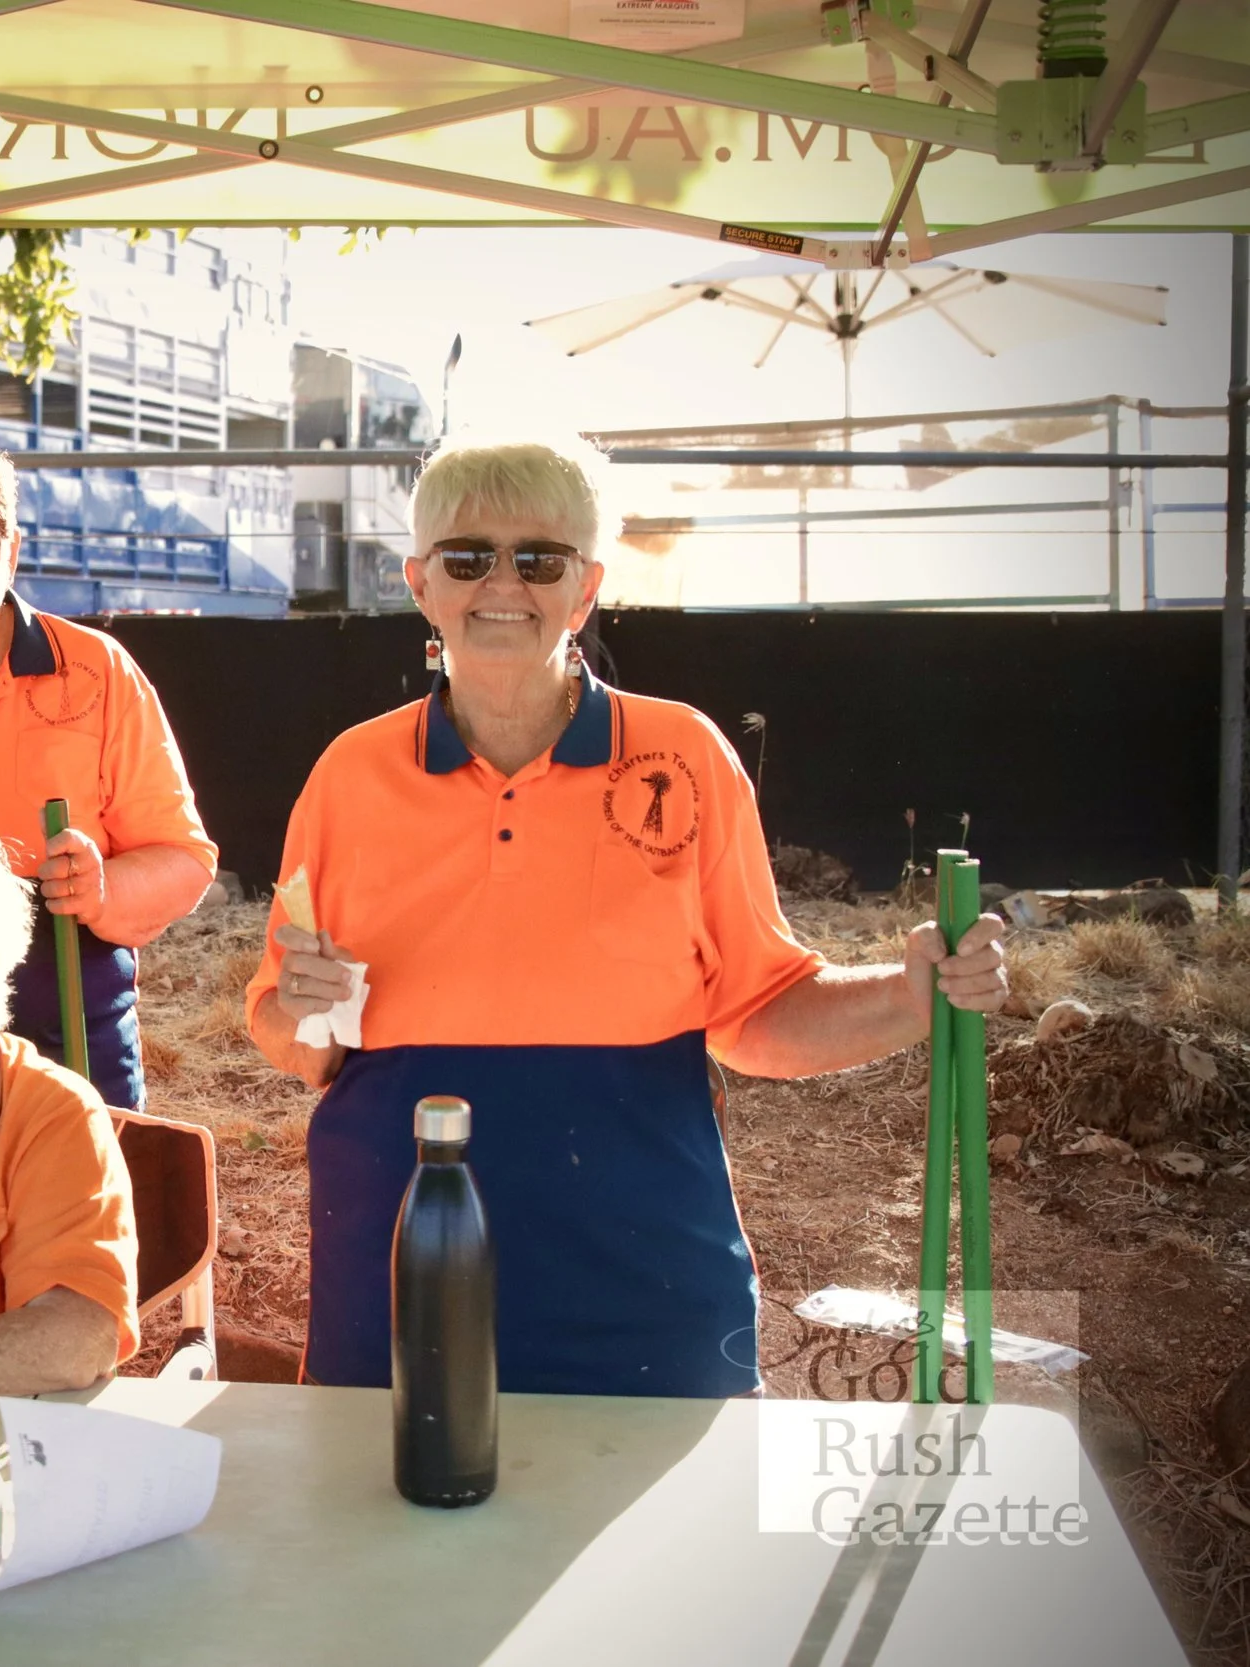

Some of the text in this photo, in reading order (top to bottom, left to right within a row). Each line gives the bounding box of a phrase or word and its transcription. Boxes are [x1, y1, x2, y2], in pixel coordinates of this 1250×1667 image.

[654, 2, 700, 10] MARQUEES
[725, 226, 801, 247] SECURE STRAP
[608, 751, 701, 802] Charters Towers
[610, 822, 625, 833] OF
[624, 832, 643, 848] THE
[644, 842, 687, 857] OUTBACK
